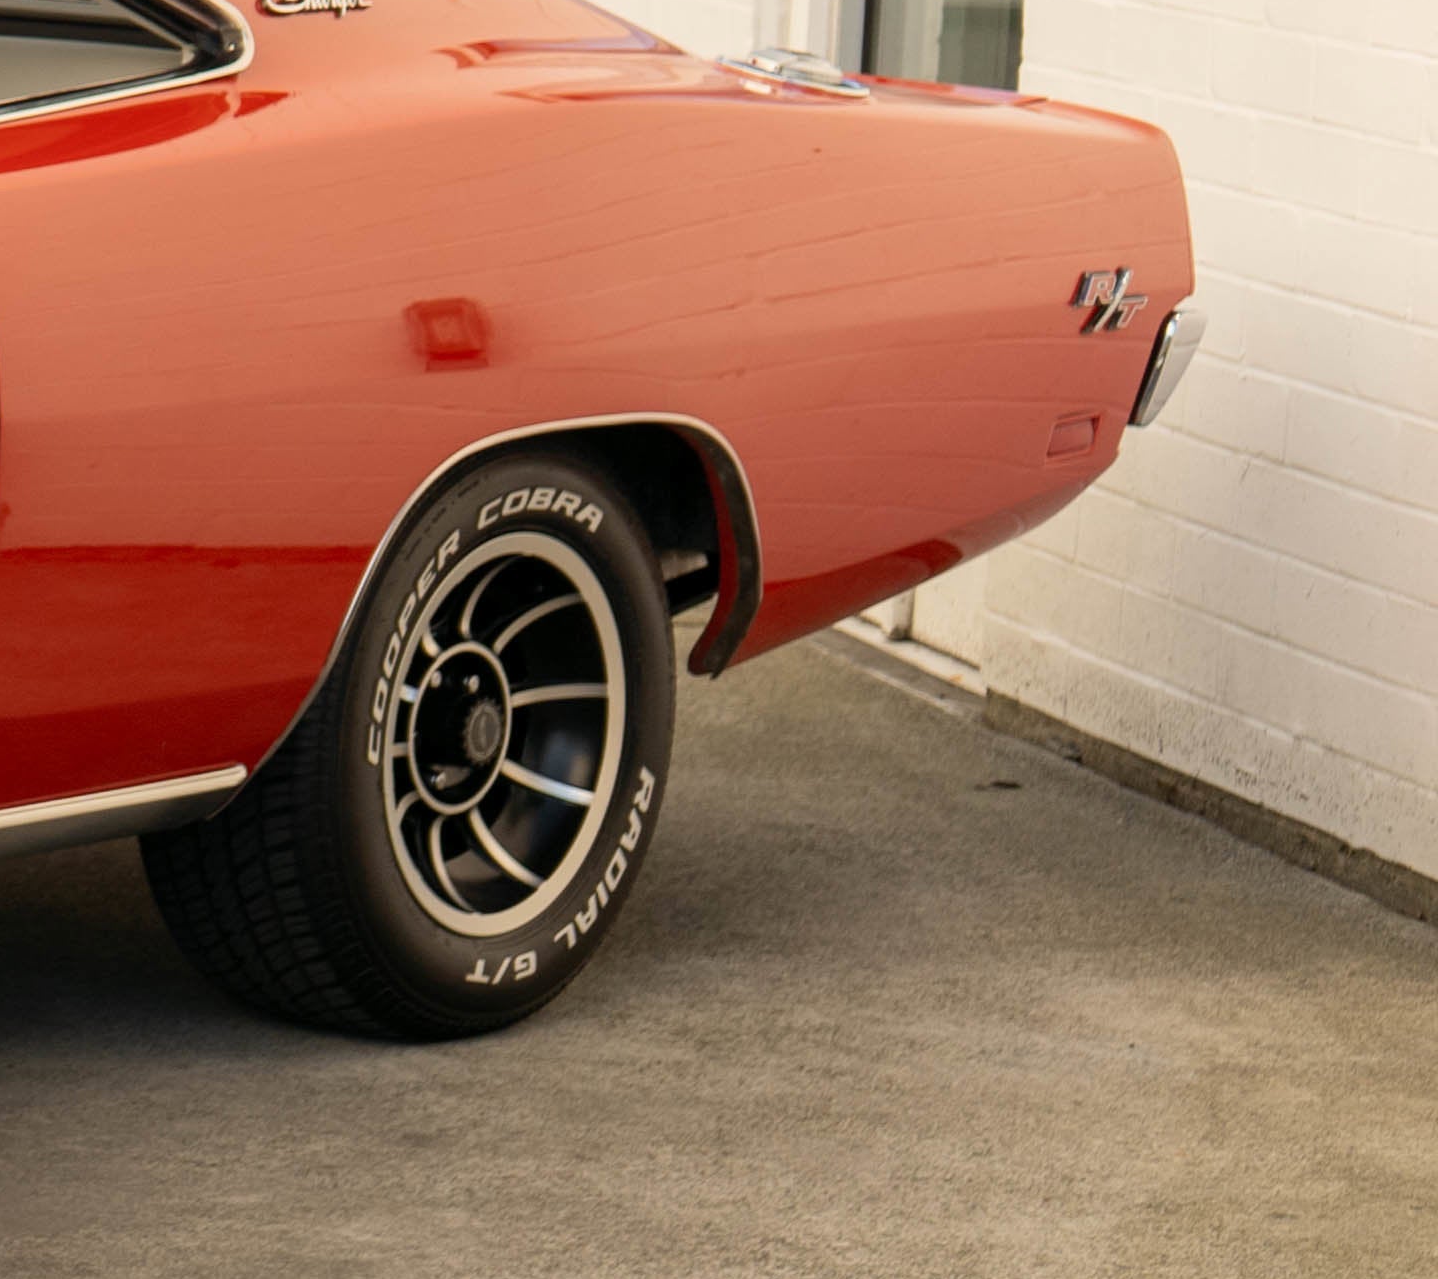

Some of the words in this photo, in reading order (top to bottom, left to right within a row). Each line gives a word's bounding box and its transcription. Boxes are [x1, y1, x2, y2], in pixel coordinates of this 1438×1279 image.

[1074, 266, 1148, 334] R/T
[368, 530, 460, 765] COOPER
[479, 487, 604, 533] COBRA
[553, 766, 656, 949] RADIAL
[465, 951, 537, 984] G/T
